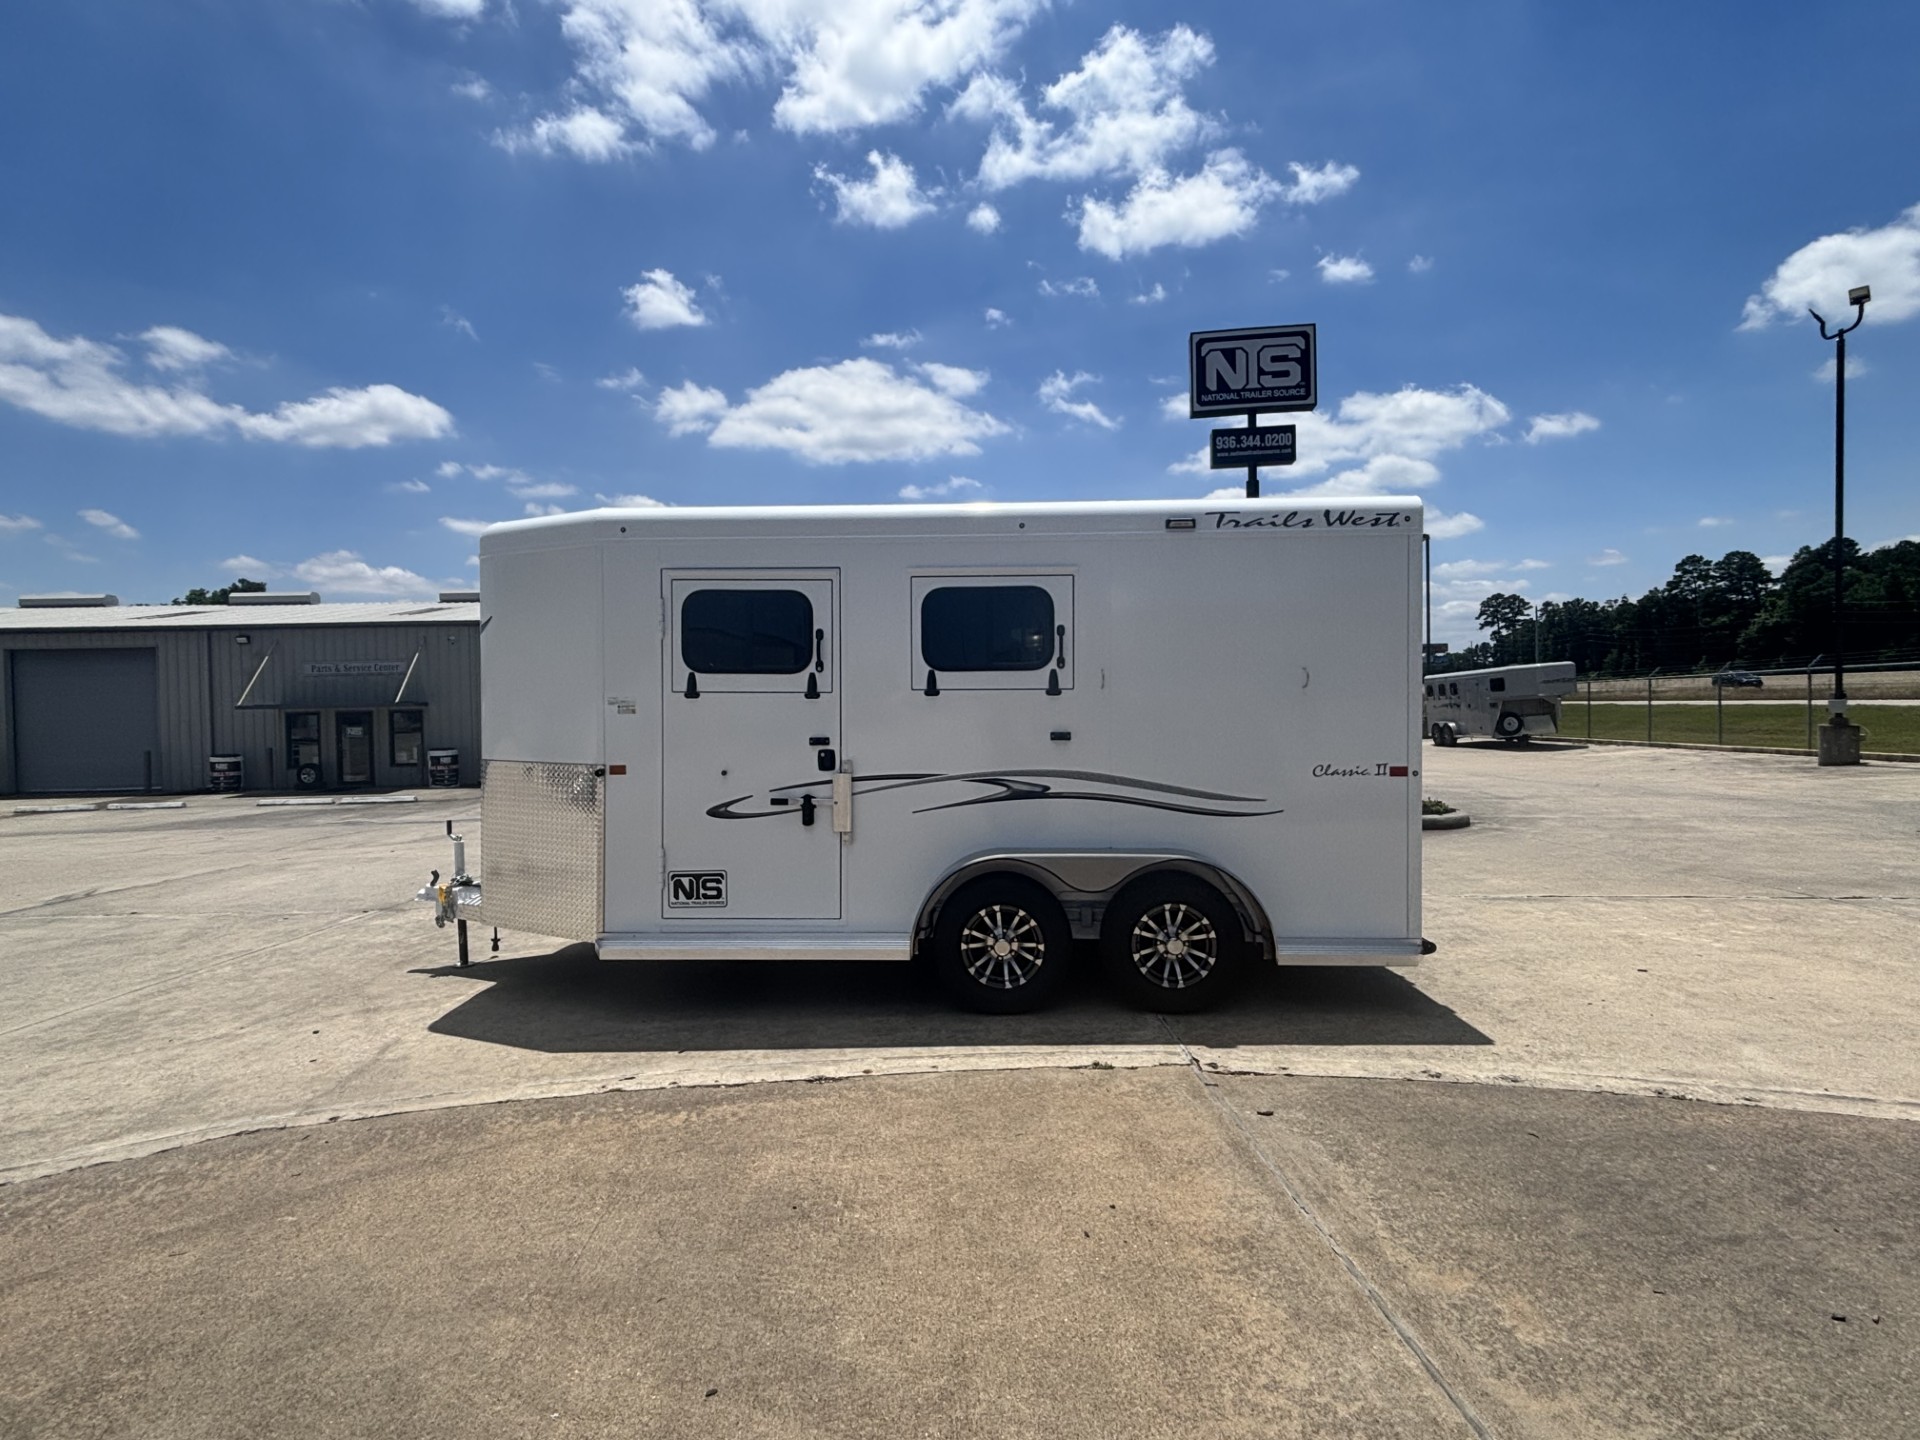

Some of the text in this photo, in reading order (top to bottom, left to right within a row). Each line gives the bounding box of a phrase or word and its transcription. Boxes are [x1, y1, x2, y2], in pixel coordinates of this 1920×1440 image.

[1201, 336, 1306, 391] NTS
[1201, 387, 1306, 402] NATIONAL TRAILER SOURCE
[1216, 432, 1292, 449] 936.344.0200
[1205, 509, 1400, 529] Trails West
[311, 664, 332, 673] Parts
[343, 663, 371, 672] Service
[374, 663, 400, 672] Center
[1312, 763, 1371, 778] Classic
[671, 872, 725, 901] NTS
